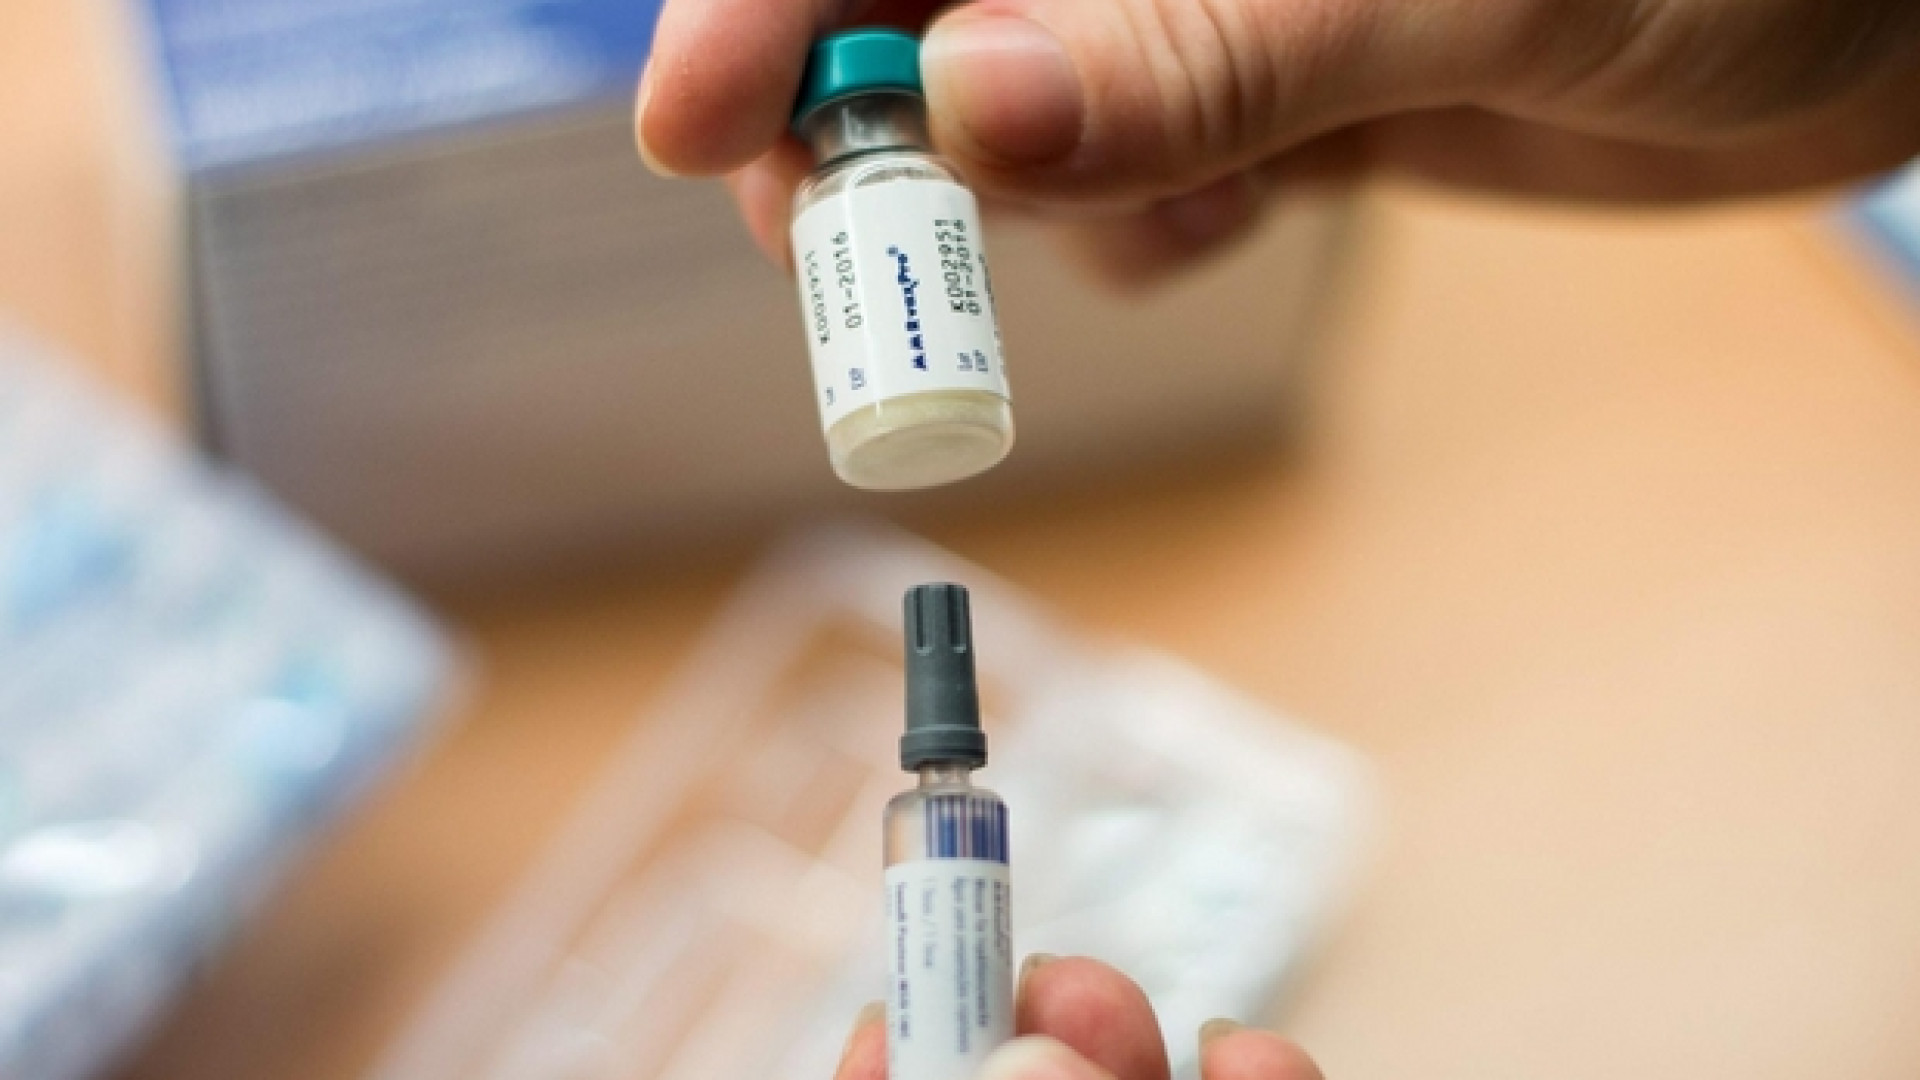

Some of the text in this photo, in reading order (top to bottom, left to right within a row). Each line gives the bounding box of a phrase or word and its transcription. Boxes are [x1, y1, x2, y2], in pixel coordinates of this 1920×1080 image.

[831, 231, 863, 329] 01-2016
[934, 219, 966, 313] K002951
[954, 219, 982, 316] 01-2016
